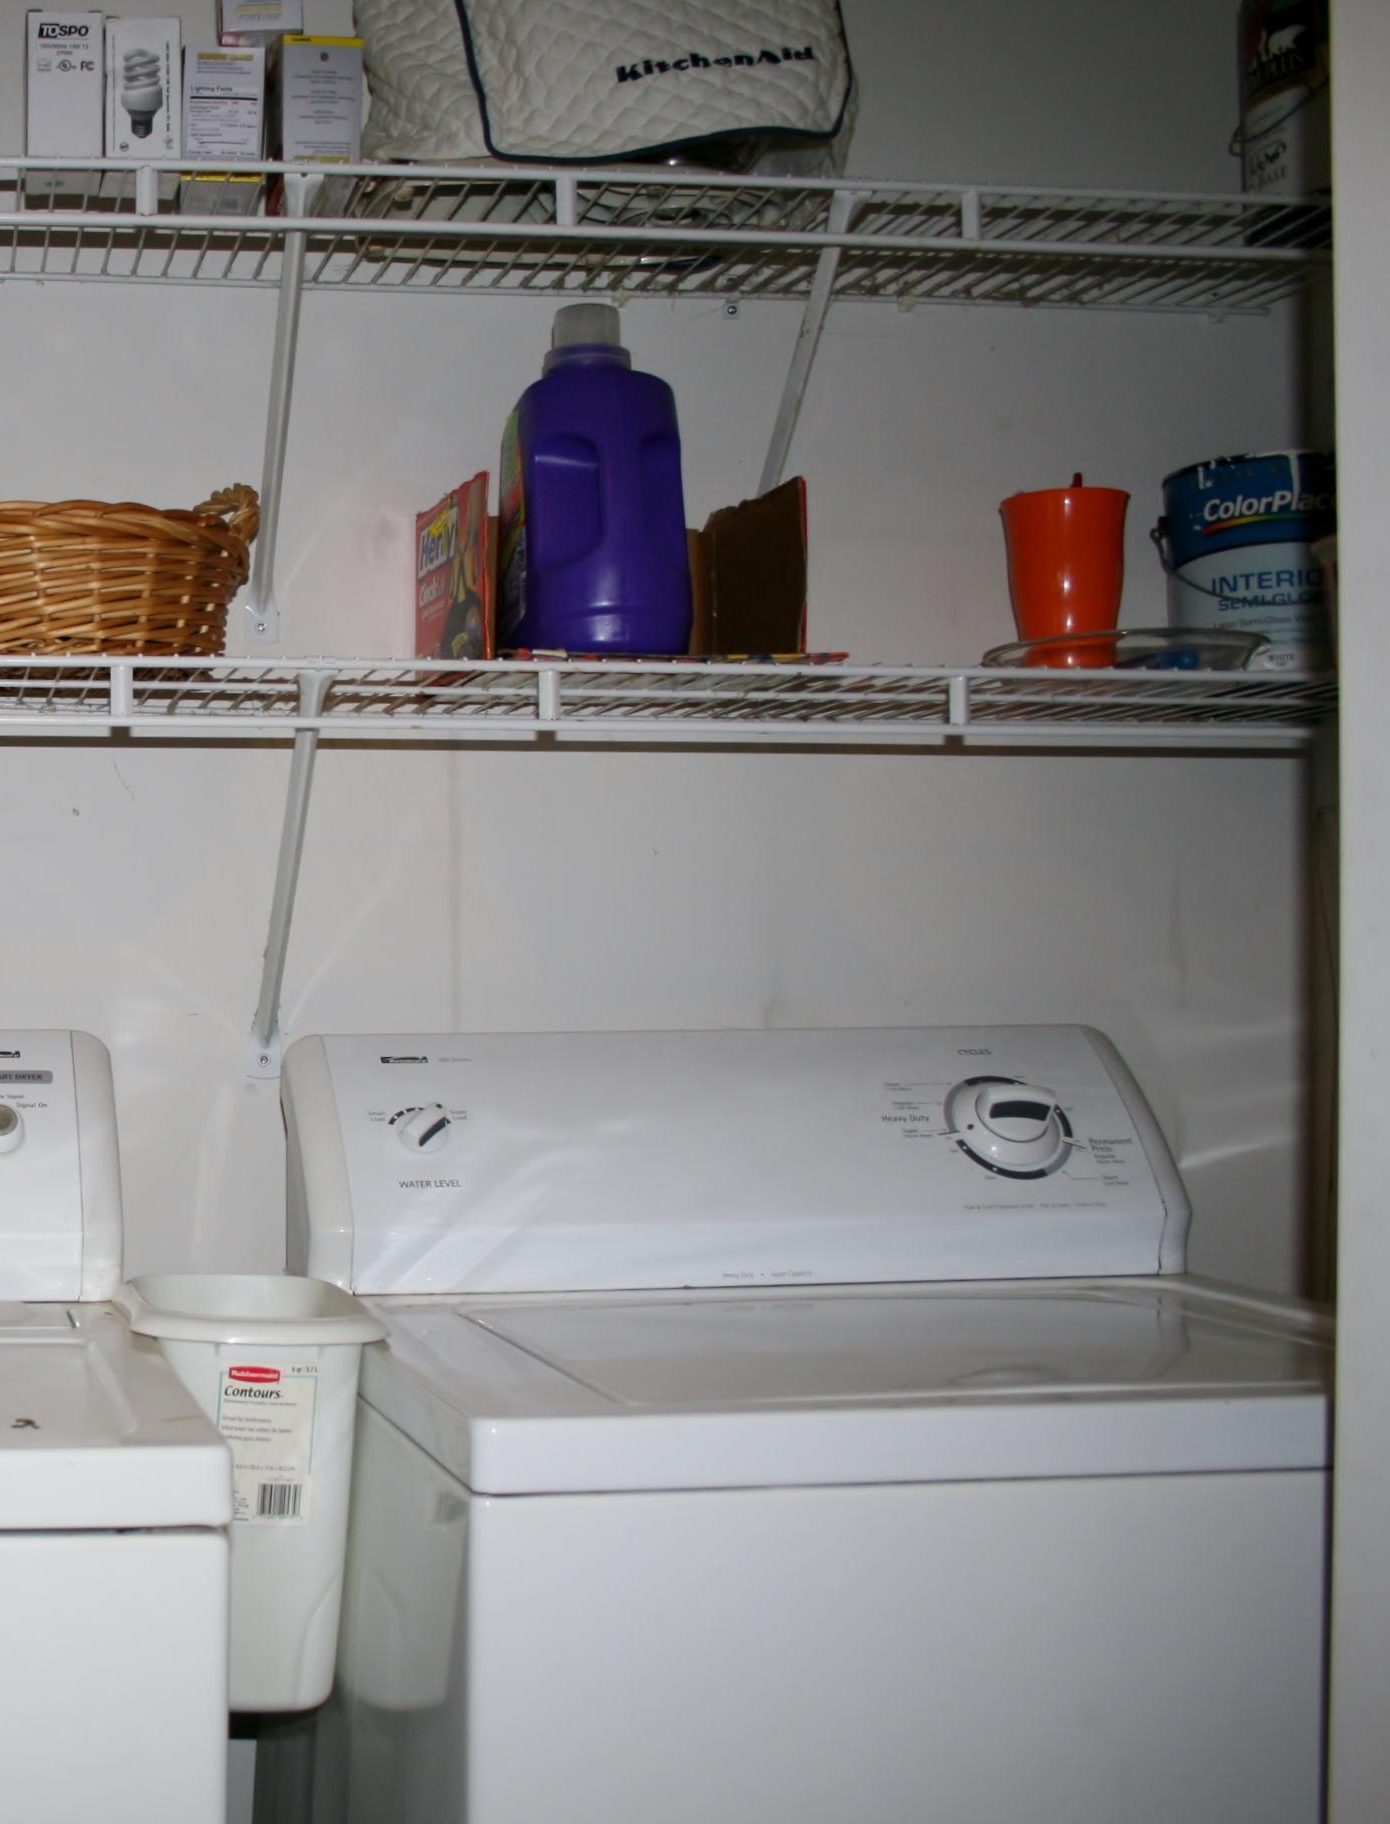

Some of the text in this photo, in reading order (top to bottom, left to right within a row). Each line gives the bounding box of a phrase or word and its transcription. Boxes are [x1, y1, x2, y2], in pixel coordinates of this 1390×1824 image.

[38, 23, 89, 38] TOSPO
[616, 46, 815, 83] KitchenAid
[1202, 490, 1336, 522] ColorPlac
[1211, 569, 1323, 594] INTERIO
[16, 1101, 36, 1109] Signal
[881, 1113, 930, 1123] Heavy Duty
[399, 1179, 462, 1188] WATER LEVEL
[231, 1370, 279, 1379] Rubbermaid
[224, 1385, 281, 1400] Contours
